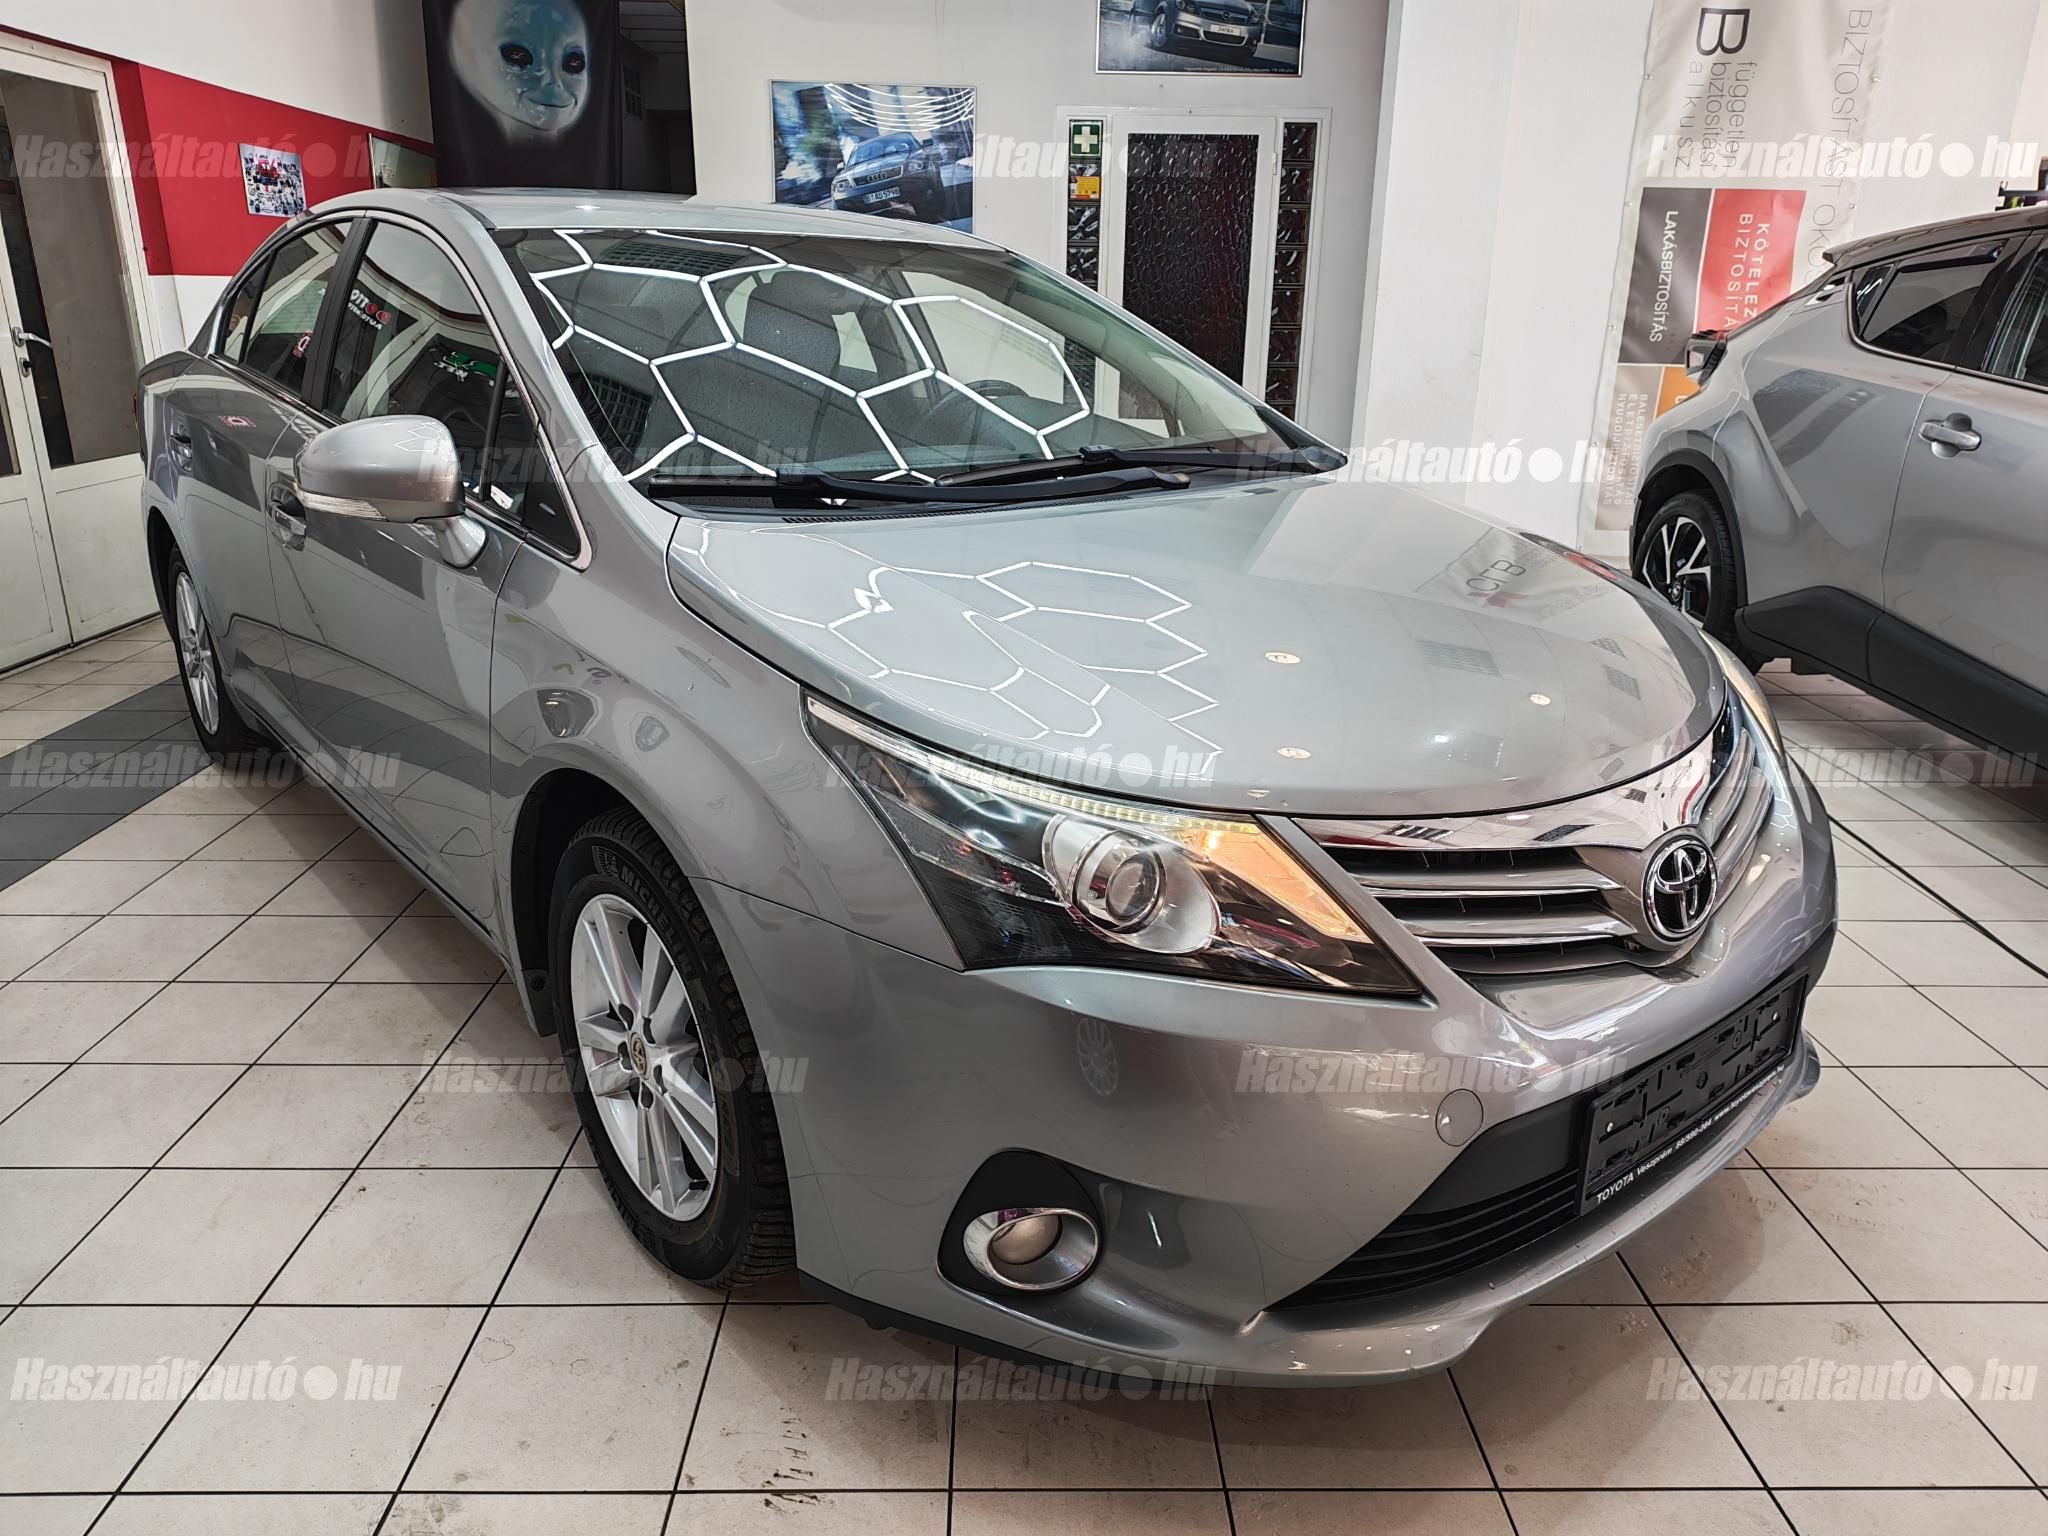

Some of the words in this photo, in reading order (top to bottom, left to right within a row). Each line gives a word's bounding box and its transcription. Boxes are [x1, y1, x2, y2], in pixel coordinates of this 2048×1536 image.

[1696, 8, 1751, 56] B
[1649, 210, 1680, 343] LAKÁSBIZTOSÍTÁS
[1597, 1171, 1634, 1204] TOYOTA
